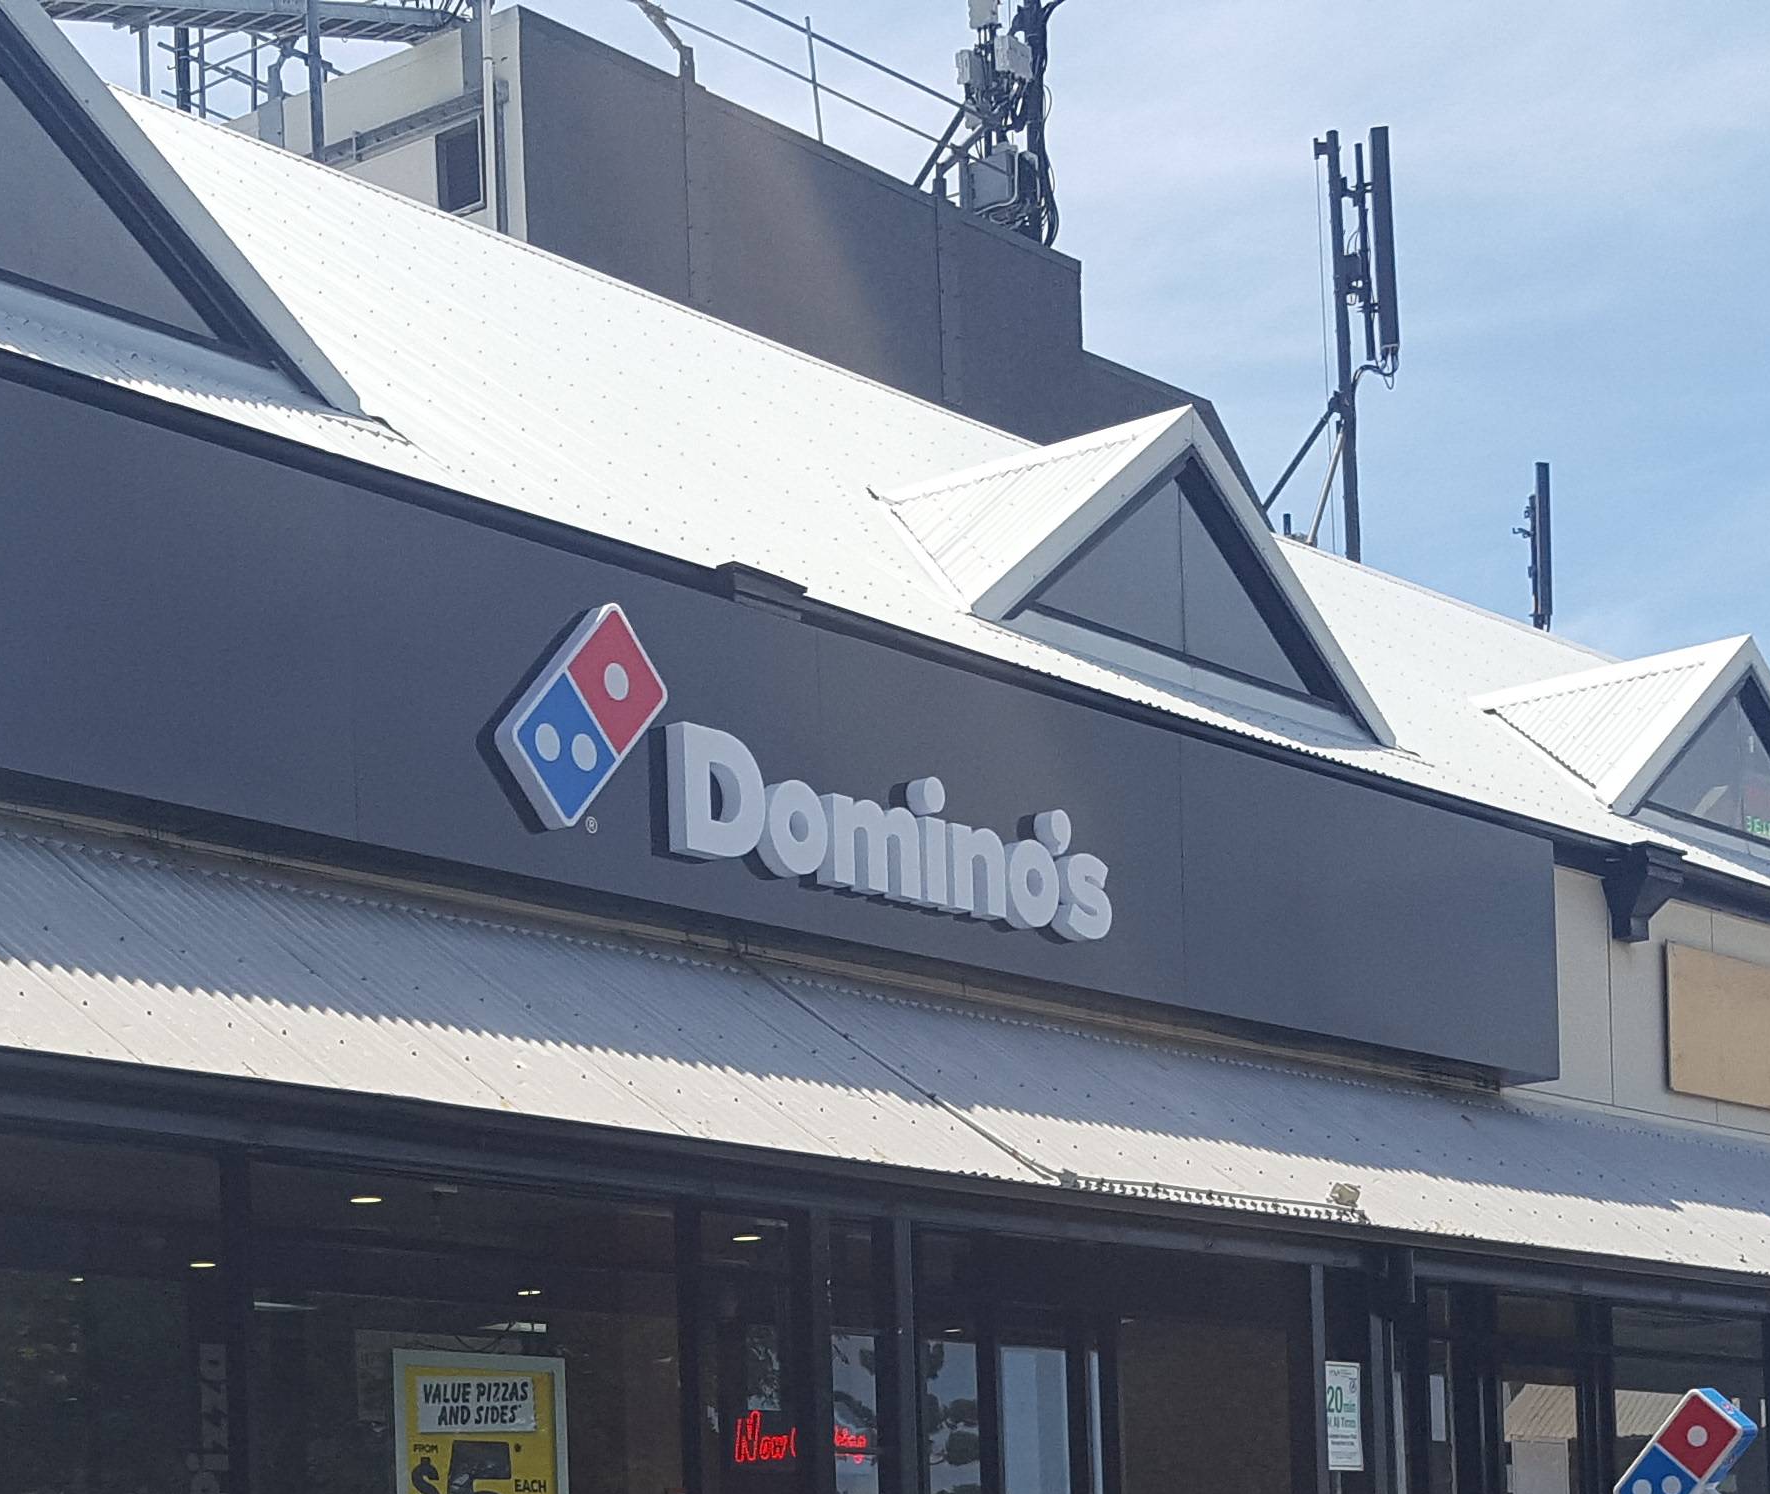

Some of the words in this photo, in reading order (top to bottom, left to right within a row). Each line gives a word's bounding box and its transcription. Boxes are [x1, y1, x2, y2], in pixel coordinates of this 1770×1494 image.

[666, 721, 1113, 942] Domino's
[423, 1382, 471, 1404] VALUE
[476, 1382, 529, 1404] PIZZAS
[1327, 1385, 1343, 1413] 20
[437, 1406, 471, 1426] AND
[735, 1411, 787, 1462] Now
[413, 1443, 438, 1454] FROM
[514, 1479, 546, 1493] EACH
